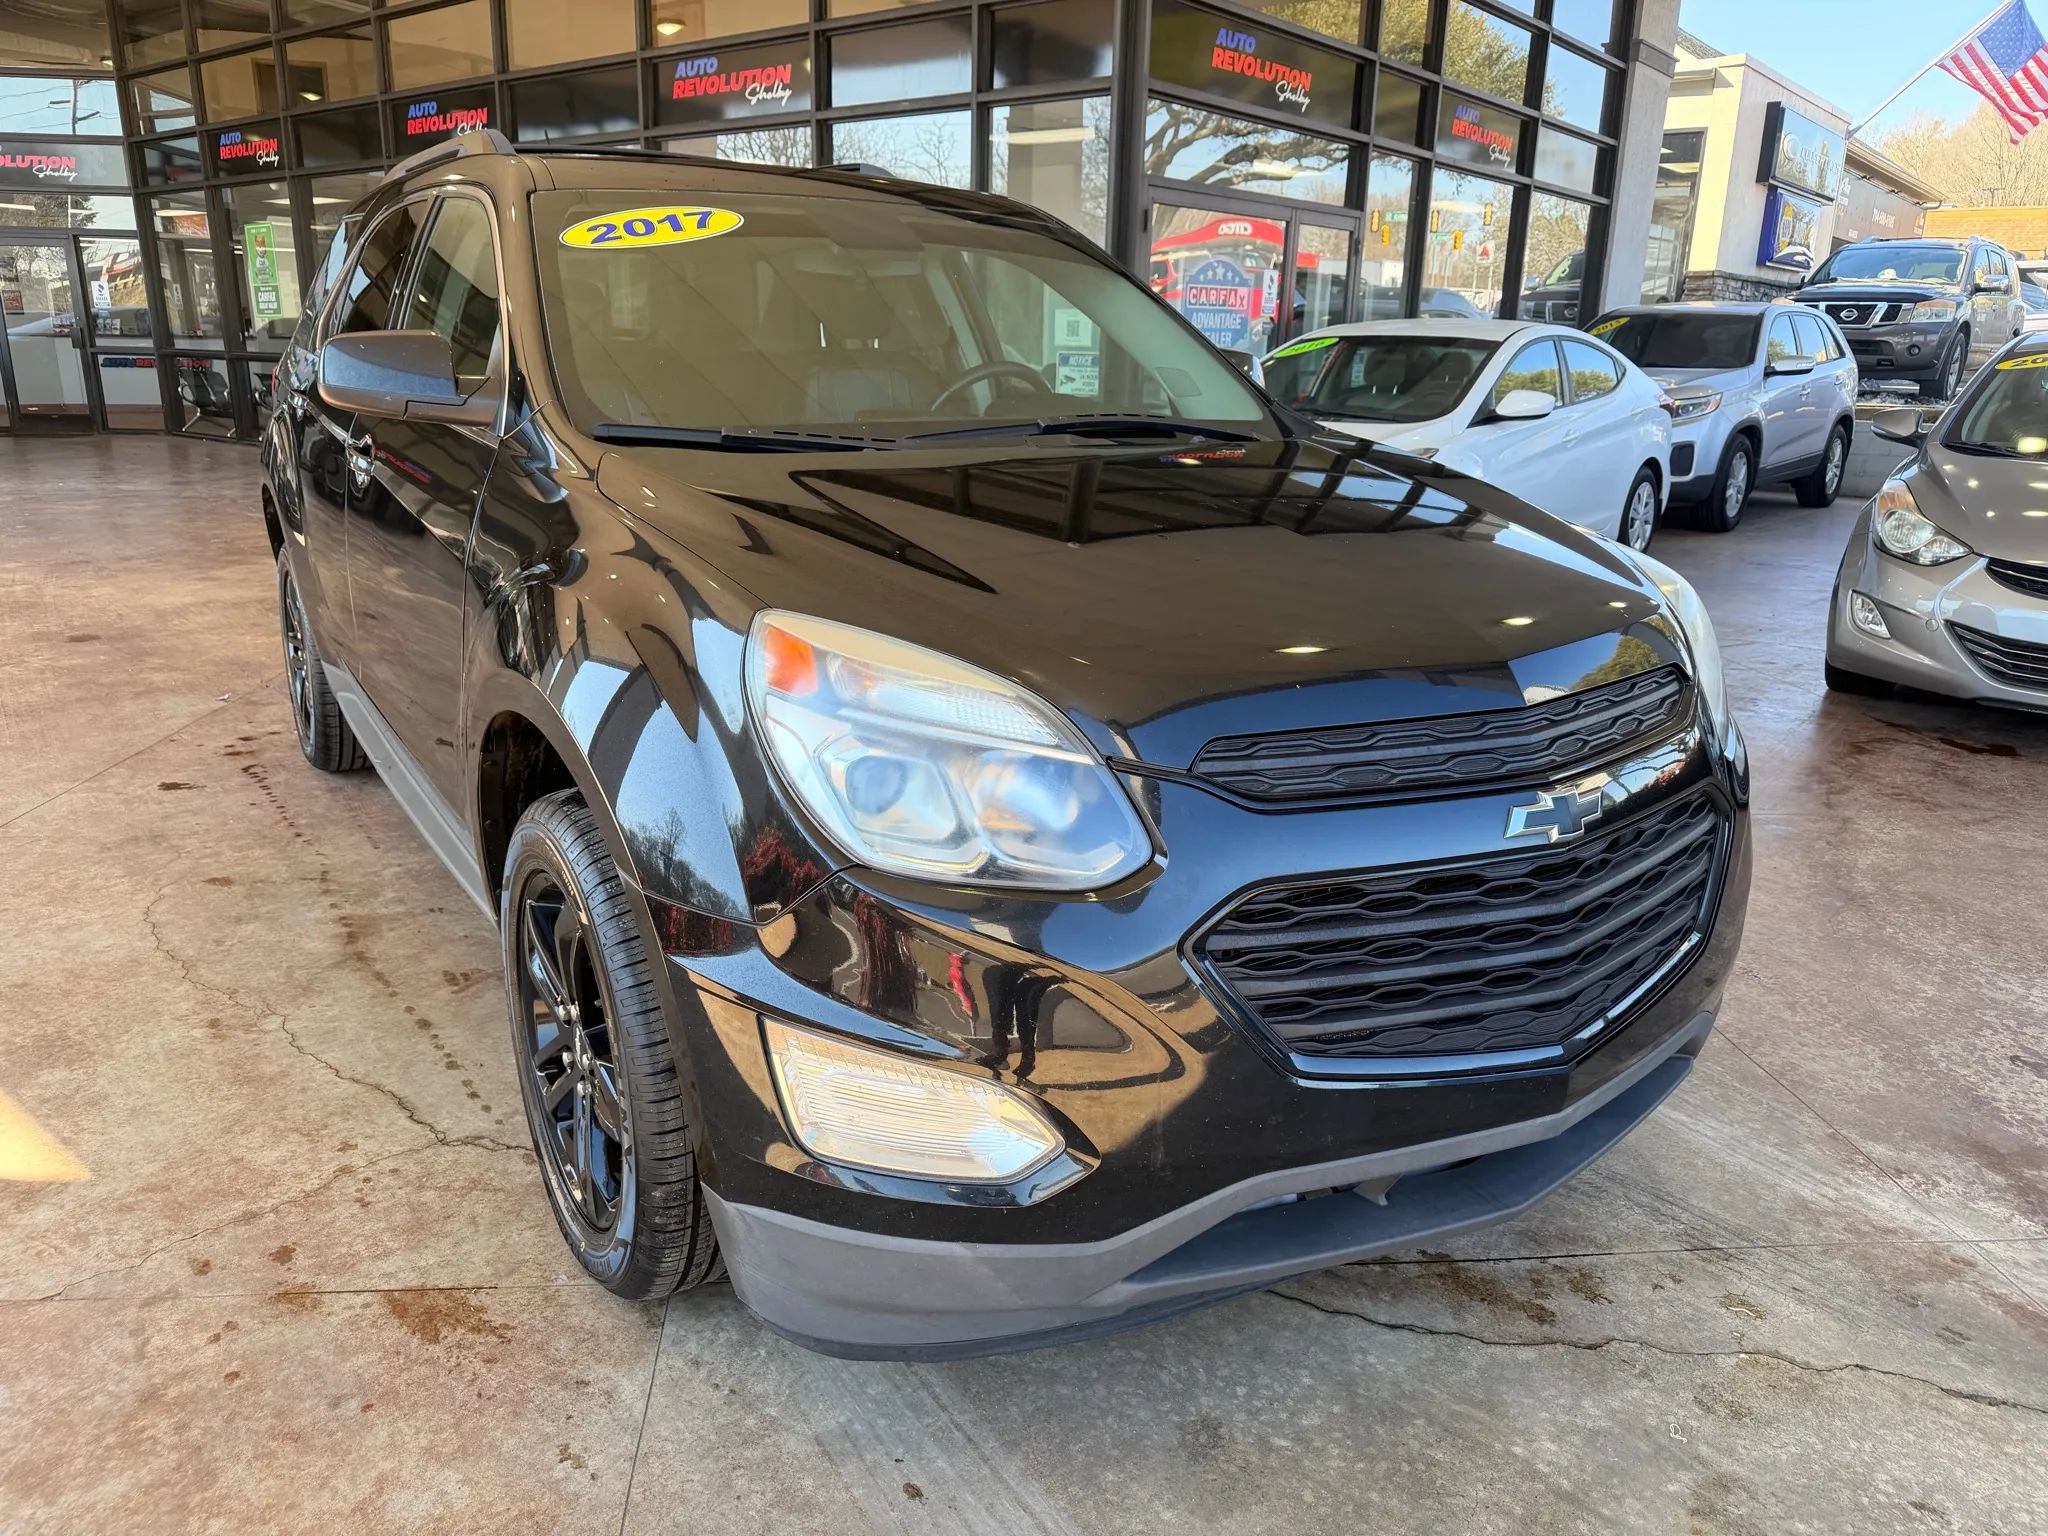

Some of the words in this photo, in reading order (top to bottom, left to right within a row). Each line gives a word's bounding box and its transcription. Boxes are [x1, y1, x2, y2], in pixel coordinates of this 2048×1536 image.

[1216, 28, 1256, 54] AUTO
[675, 56, 718, 79] AUTO
[1212, 47, 1312, 91] REVOLUTION
[673, 64, 792, 99] REVOLUTION
[745, 78, 793, 107] Shelby
[1275, 80, 1311, 112] Shelby
[407, 107, 488, 135] REVOLUTION
[408, 101, 437, 118] AUTO
[1456, 105, 1480, 124] AUTO
[220, 132, 241, 145] AUTO
[1452, 119, 1513, 151] REVOLUTION
[220, 138, 278, 160] REVOLUTION
[32, 164, 78, 182] Shelby
[586, 210, 715, 245] 2017
[1189, 286, 1248, 309] CARFAX
[1191, 311, 1242, 329] ADVANTAGE
[1204, 330, 1232, 347] ALER
